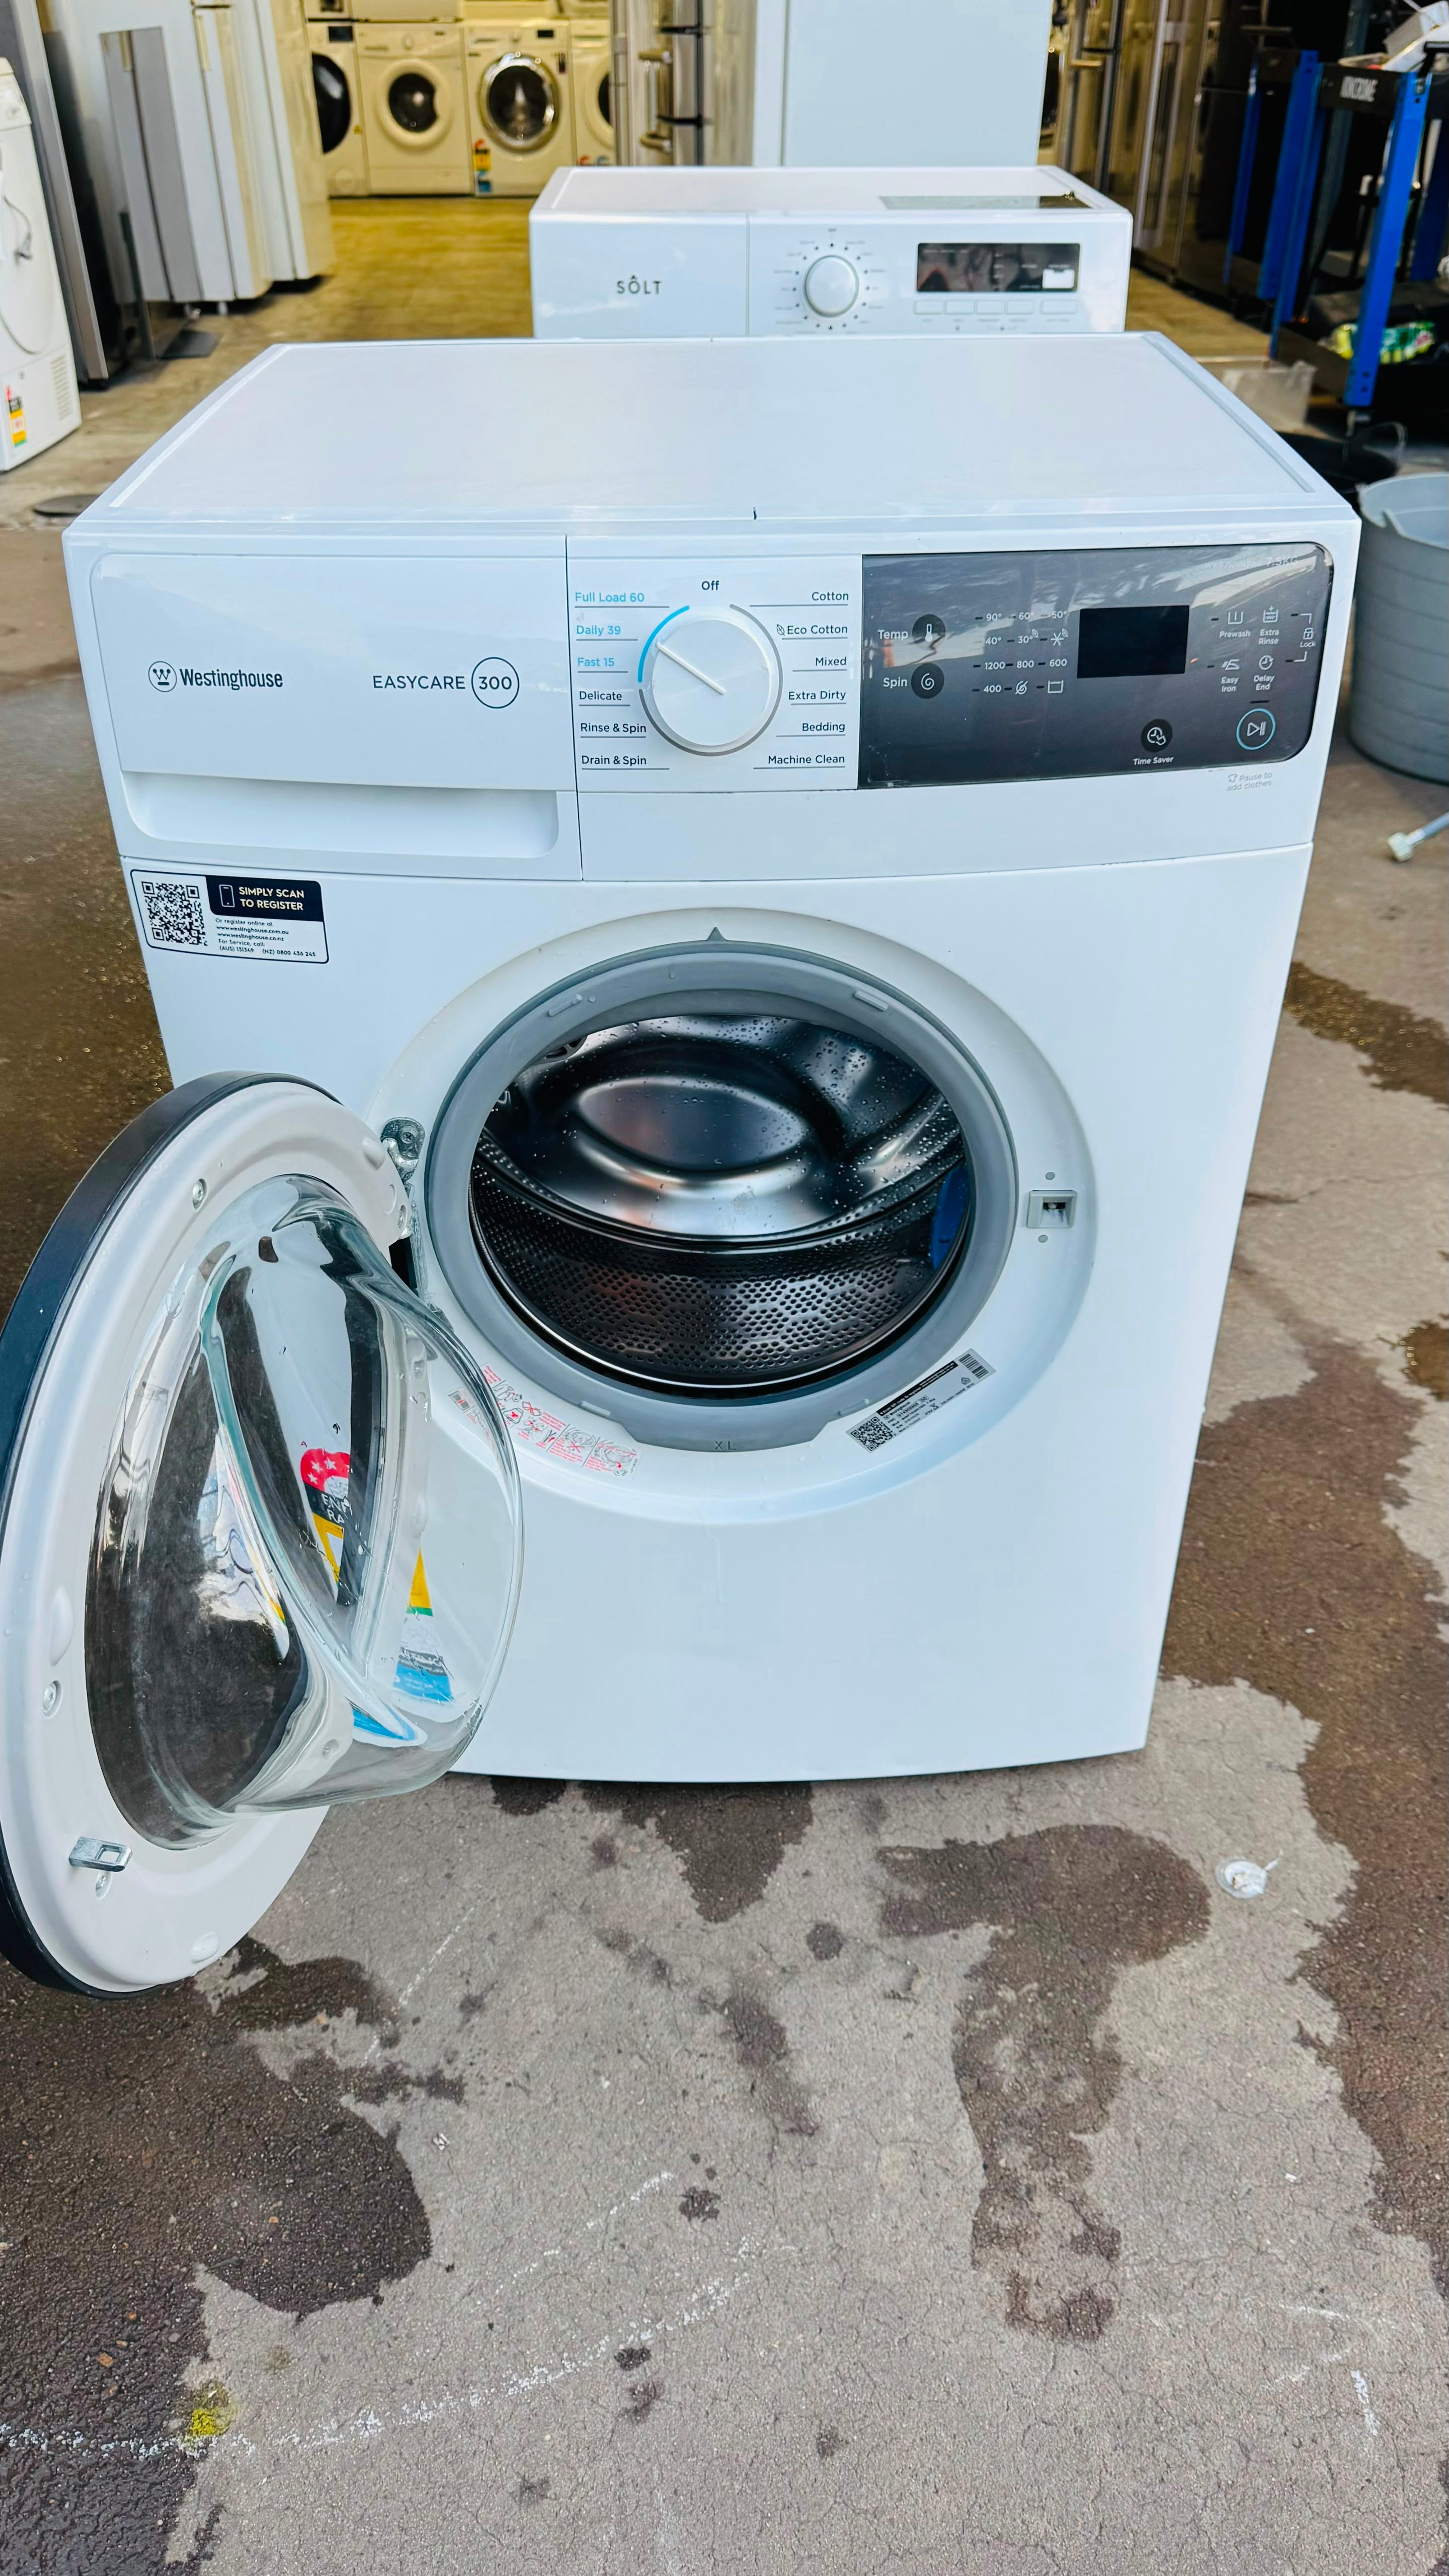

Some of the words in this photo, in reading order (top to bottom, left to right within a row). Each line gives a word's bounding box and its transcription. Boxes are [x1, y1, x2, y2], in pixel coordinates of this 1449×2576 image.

[701, 580, 719, 591] Off
[575, 592, 595, 602] Full
[599, 592, 626, 602] Load
[629, 592, 645, 602] 60
[812, 591, 849, 601] Cotton
[986, 613, 1002, 621] 90°
[1018, 612, 1034, 620] 60°
[576, 625, 604, 636] Daily
[607, 625, 621, 635] 39
[787, 625, 807, 635] Eco
[811, 624, 848, 634] Cotton
[877, 629, 908, 640] Temp
[1219, 630, 1251, 638] Prewash
[985, 636, 1002, 646] 40°
[1018, 635, 1033, 644] 30°
[578, 657, 600, 667] Fast
[603, 658, 615, 667] 15
[815, 657, 847, 666] Mixed
[985, 661, 1005, 670] 1200
[1016, 660, 1034, 669] 800
[1049, 659, 1068, 667] 600
[179, 668, 283, 691] Westinghouse
[373, 675, 465, 689] EASYCARE
[478, 676, 512, 690] 300
[883, 677, 908, 689] Spin
[1221, 677, 1239, 685] Easy
[1254, 675, 1275, 683] Delay
[983, 685, 1001, 693] 400
[579, 691, 622, 701] Delicate
[789, 691, 816, 700] Extra
[820, 690, 846, 701] Dirty
[580, 722, 610, 733] Rinse
[613, 723, 620, 733] &
[622, 723, 647, 734] Spin
[802, 722, 845, 733] Bedding
[582, 755, 610, 765] Drain
[613, 756, 620, 765] &
[623, 756, 647, 767] Spin
[768, 755, 812, 764] Machine
[816, 754, 845, 763] Clean
[1239, 774, 1262, 782] Pause
[1226, 783, 1242, 791] add
[1244, 780, 1272, 789] clothes
[238, 887, 274, 897] SIMPLY
[276, 888, 304, 899] SCAN
[240, 898, 254, 908] TO
[257, 900, 304, 911] REGISTER
[216, 926, 289, 935] www.westinghouse.com.au
[217, 932, 284, 941] www.westinghouse.co.nz
[714, 1440, 737, 1451] XL
